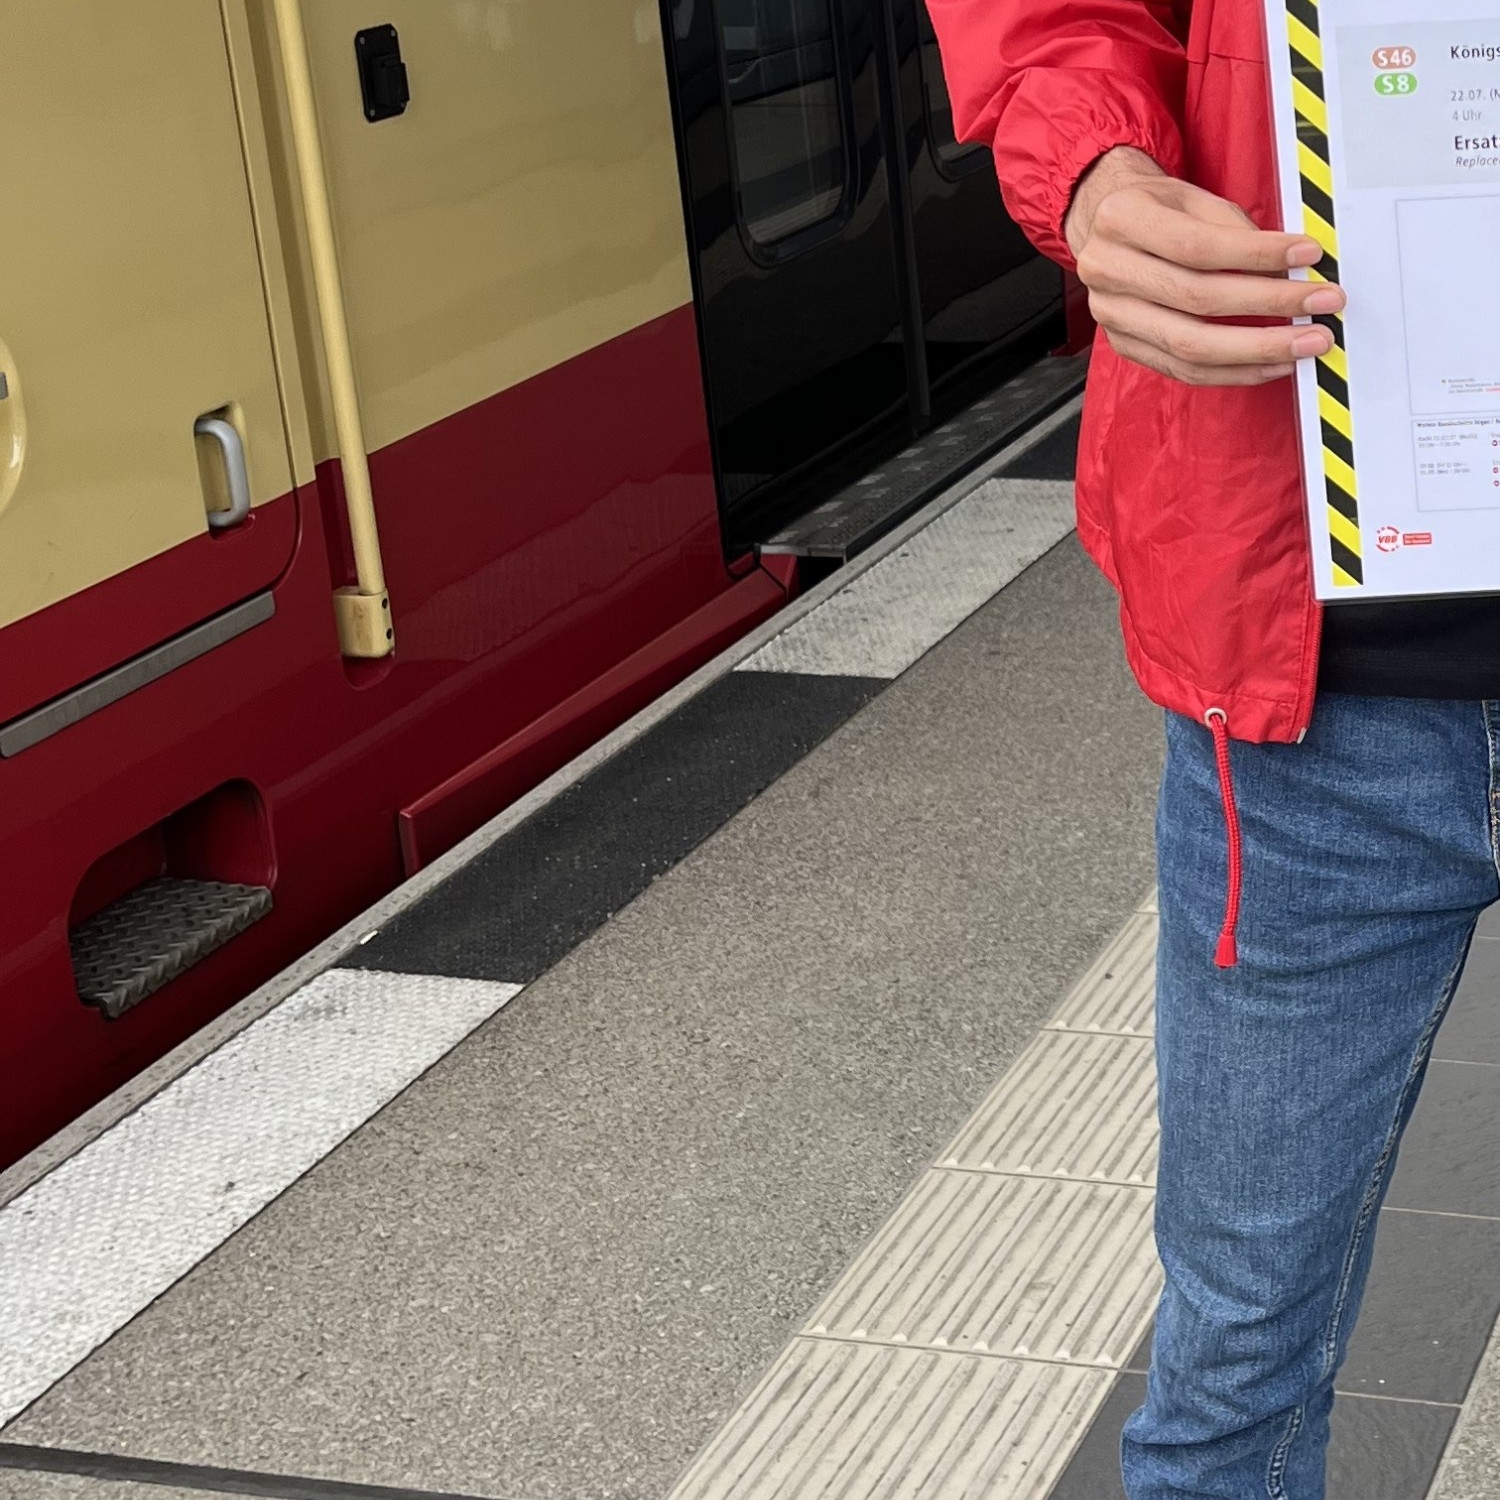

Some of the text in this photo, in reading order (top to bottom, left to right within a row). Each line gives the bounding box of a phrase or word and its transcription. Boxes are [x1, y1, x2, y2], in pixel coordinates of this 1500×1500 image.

[1451, 109, 1482, 122] 4 Uhr
[1378, 535, 1398, 544] VBB
